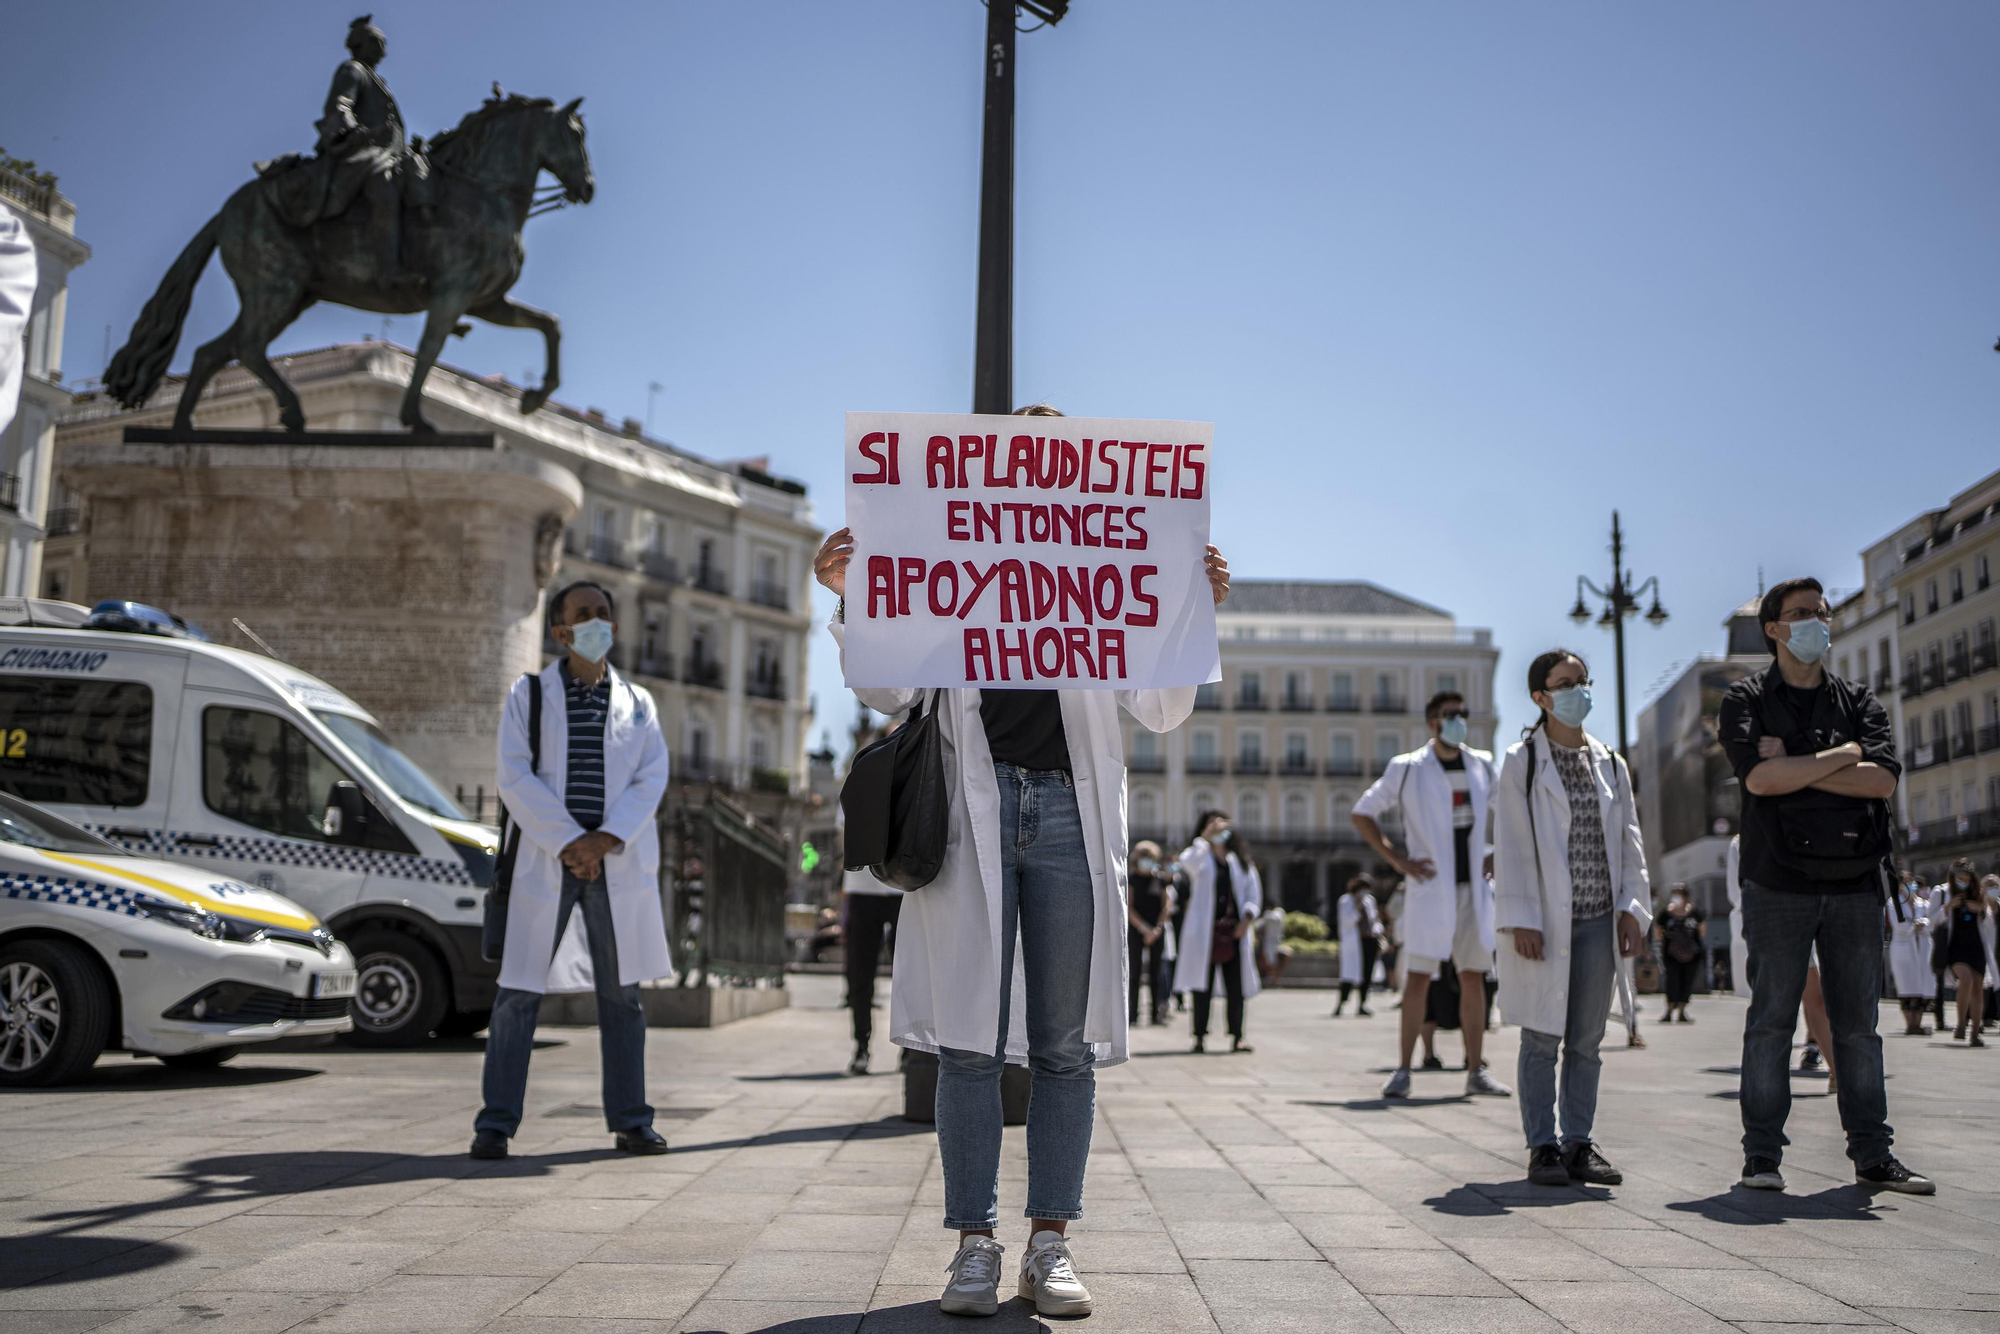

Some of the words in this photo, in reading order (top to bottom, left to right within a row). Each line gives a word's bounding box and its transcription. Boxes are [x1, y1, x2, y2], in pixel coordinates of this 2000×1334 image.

[852, 432, 901, 485] SI
[926, 435, 1205, 500] APLAUDISTEIS
[947, 500, 1148, 551] ENTONCES
[867, 555, 1159, 627] APOYADNOS
[0, 648, 108, 671] CIUDADANO
[964, 627, 1127, 681] AHORA
